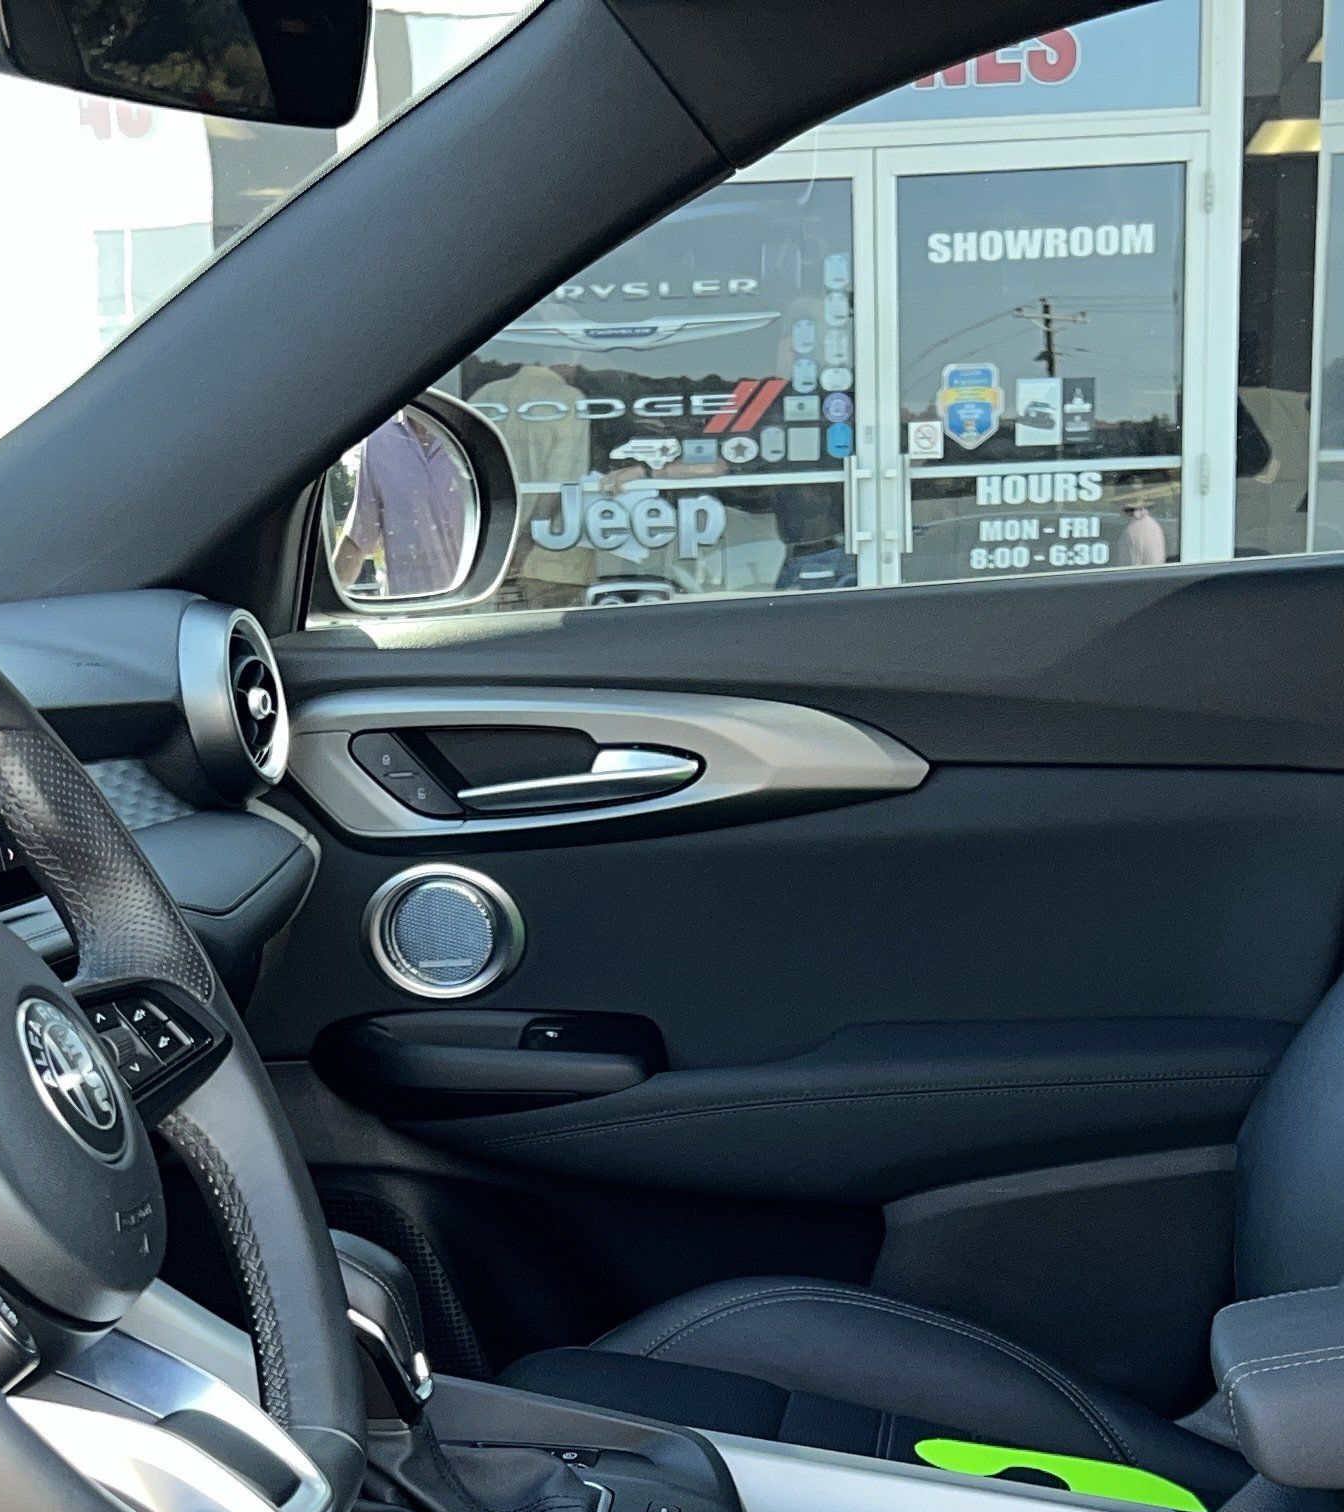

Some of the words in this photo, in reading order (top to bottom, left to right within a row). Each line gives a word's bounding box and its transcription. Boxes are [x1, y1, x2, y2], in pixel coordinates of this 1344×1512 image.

[927, 223, 1155, 263] SHOWROOM
[466, 393, 739, 422] DODGE
[975, 471, 1103, 506] HOURS
[530, 482, 727, 560] Jeep
[979, 519, 1040, 542] MON
[1058, 516, 1101, 539] FRI
[969, 546, 1030, 570] 8:00
[1048, 542, 1110, 567] 6:30
